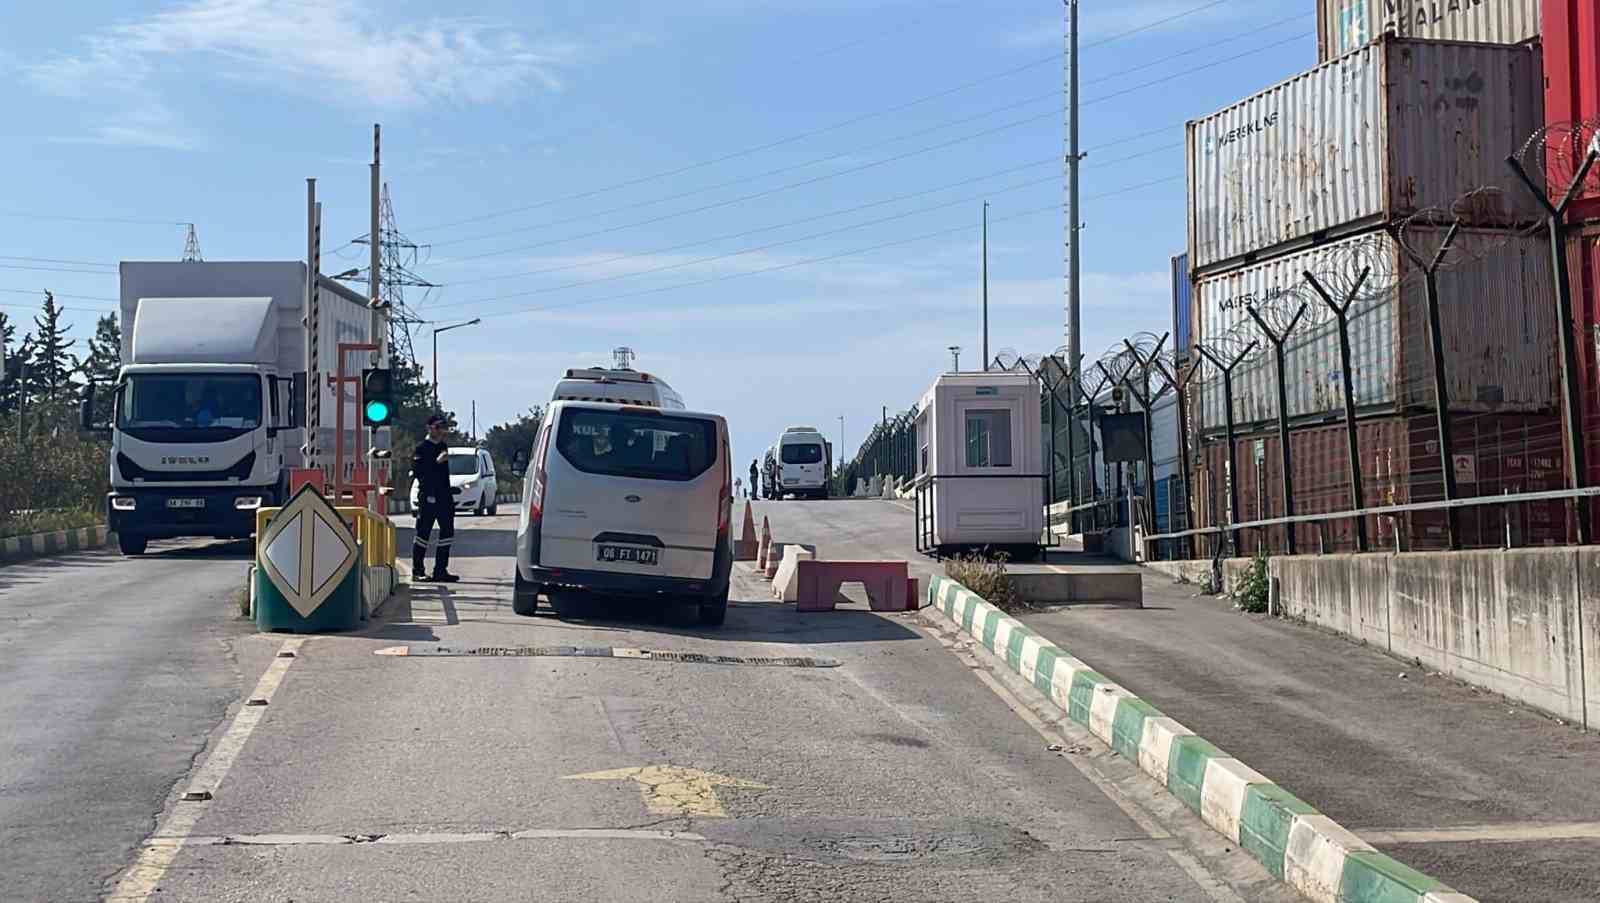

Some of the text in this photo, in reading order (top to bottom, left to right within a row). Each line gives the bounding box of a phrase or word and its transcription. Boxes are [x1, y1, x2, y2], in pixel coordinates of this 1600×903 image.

[603, 547, 656, 561] 06 FT 1471
